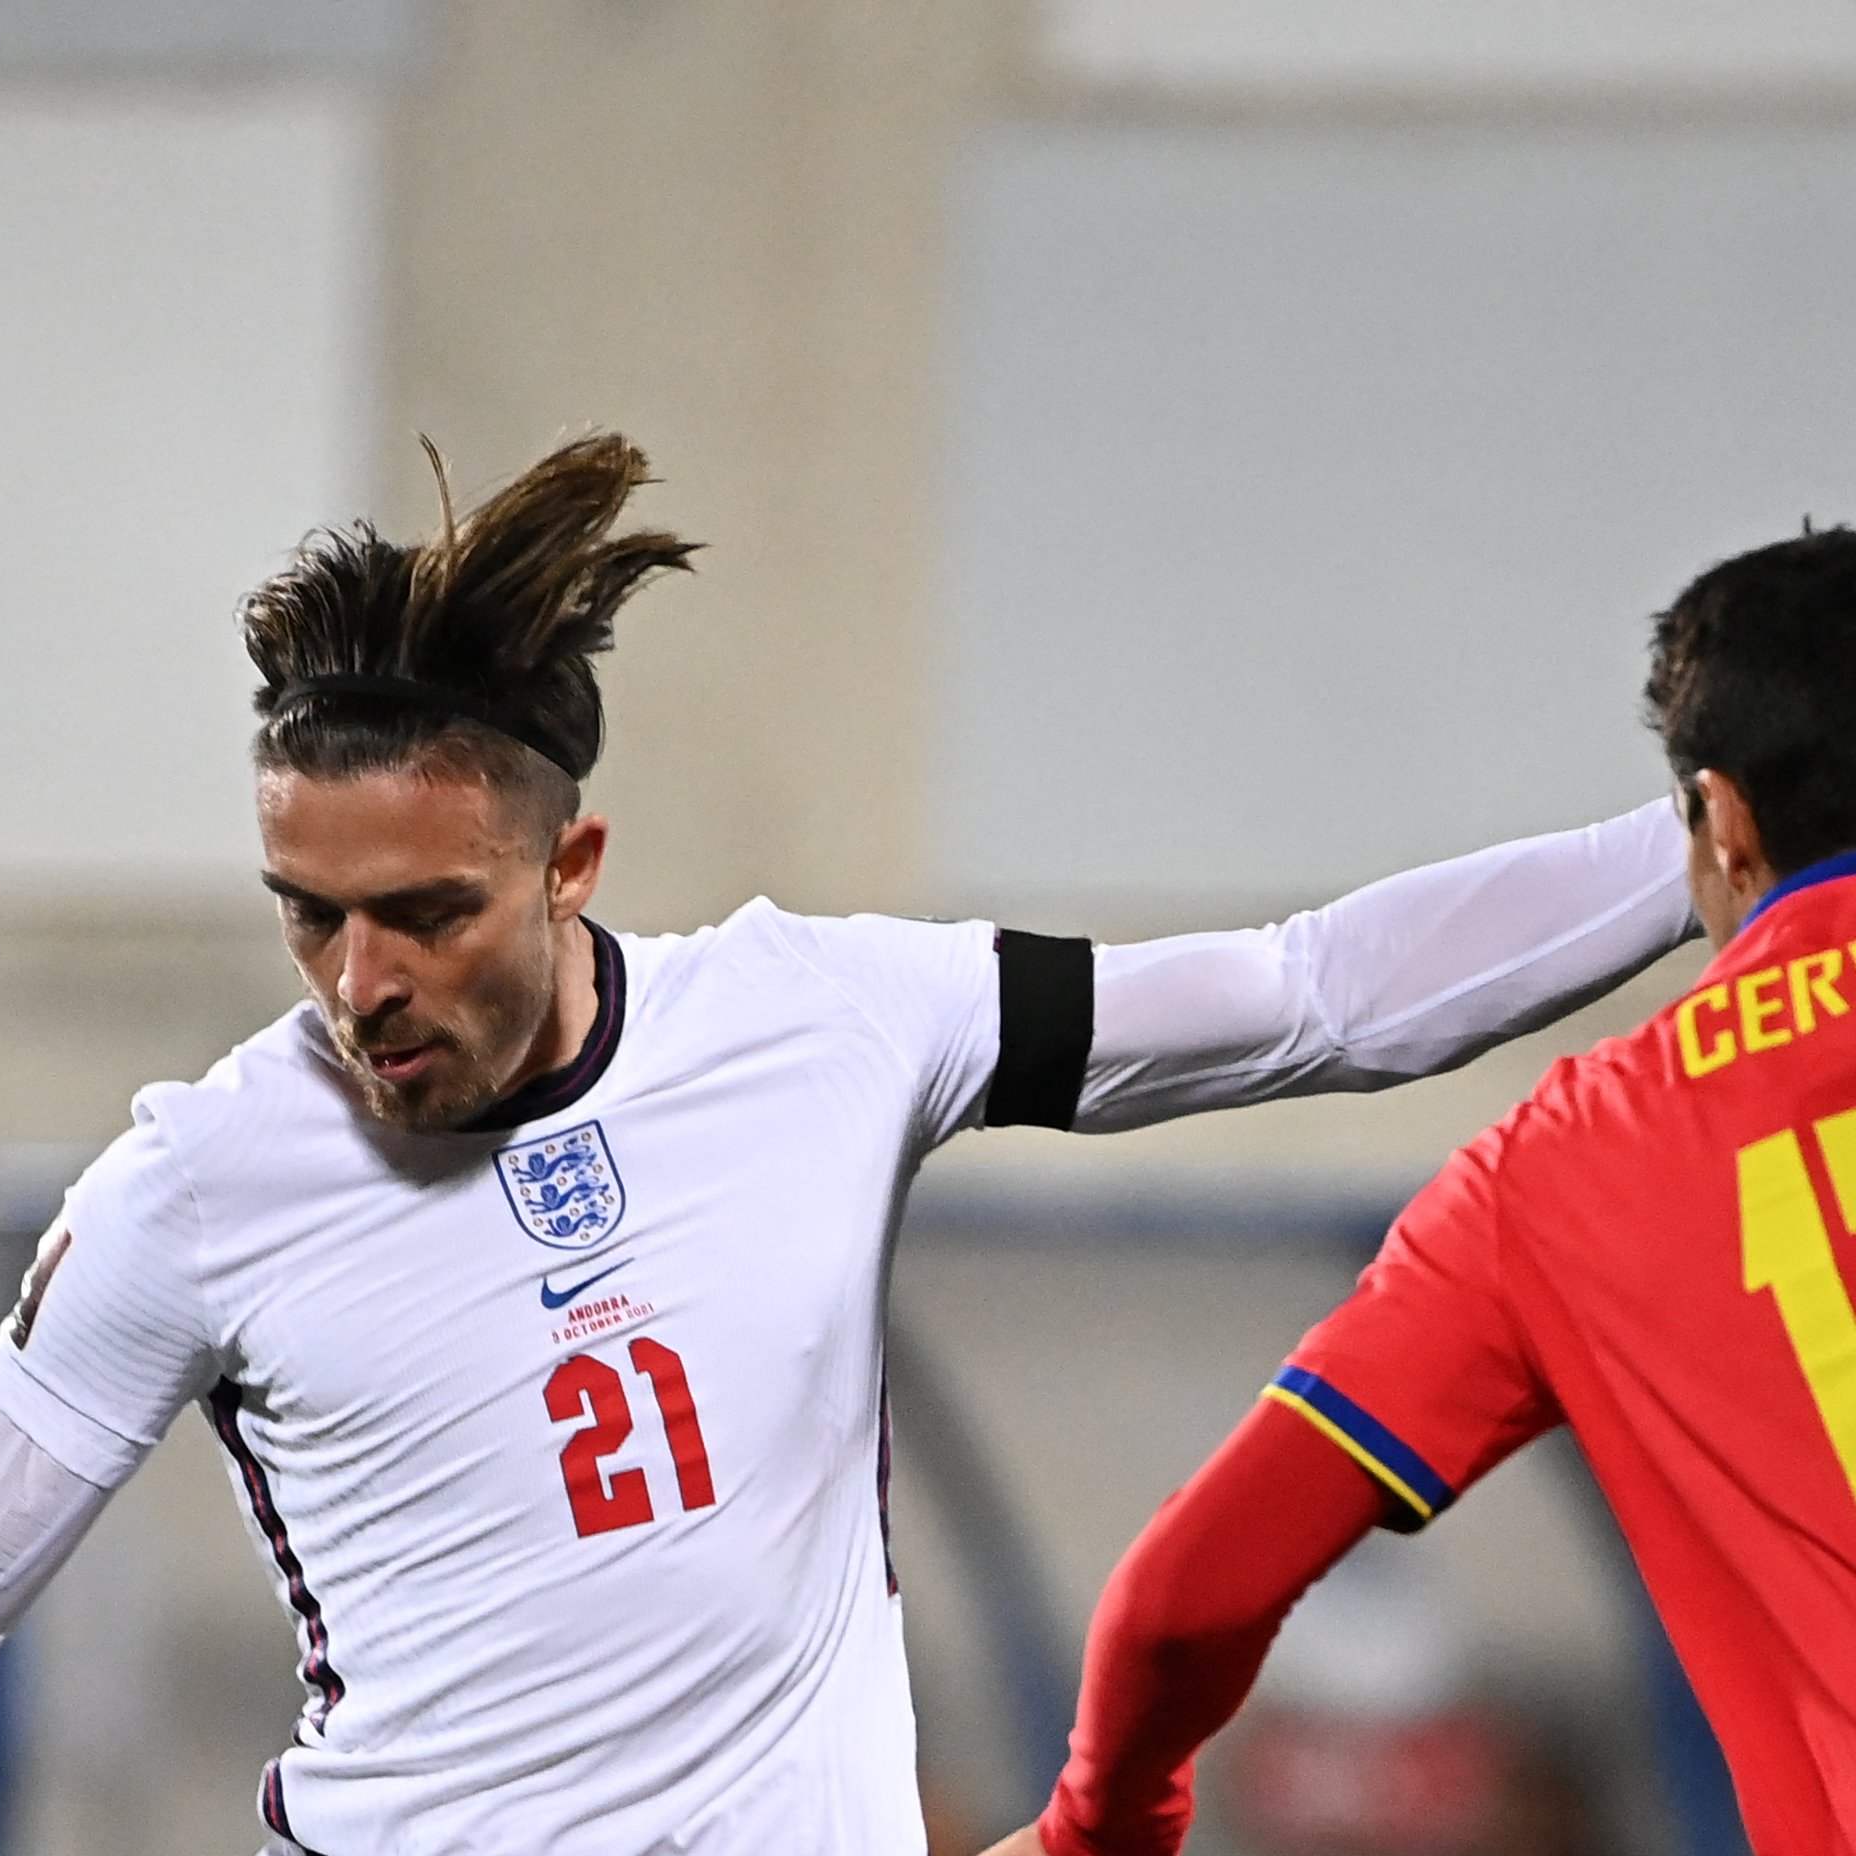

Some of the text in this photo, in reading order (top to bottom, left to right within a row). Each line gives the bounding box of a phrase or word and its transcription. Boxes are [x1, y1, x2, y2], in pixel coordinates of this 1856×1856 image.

[567, 1294, 630, 1324] ANDORRA
[563, 1314, 623, 1341] OCTOBER
[542, 1336, 716, 1538] 21
